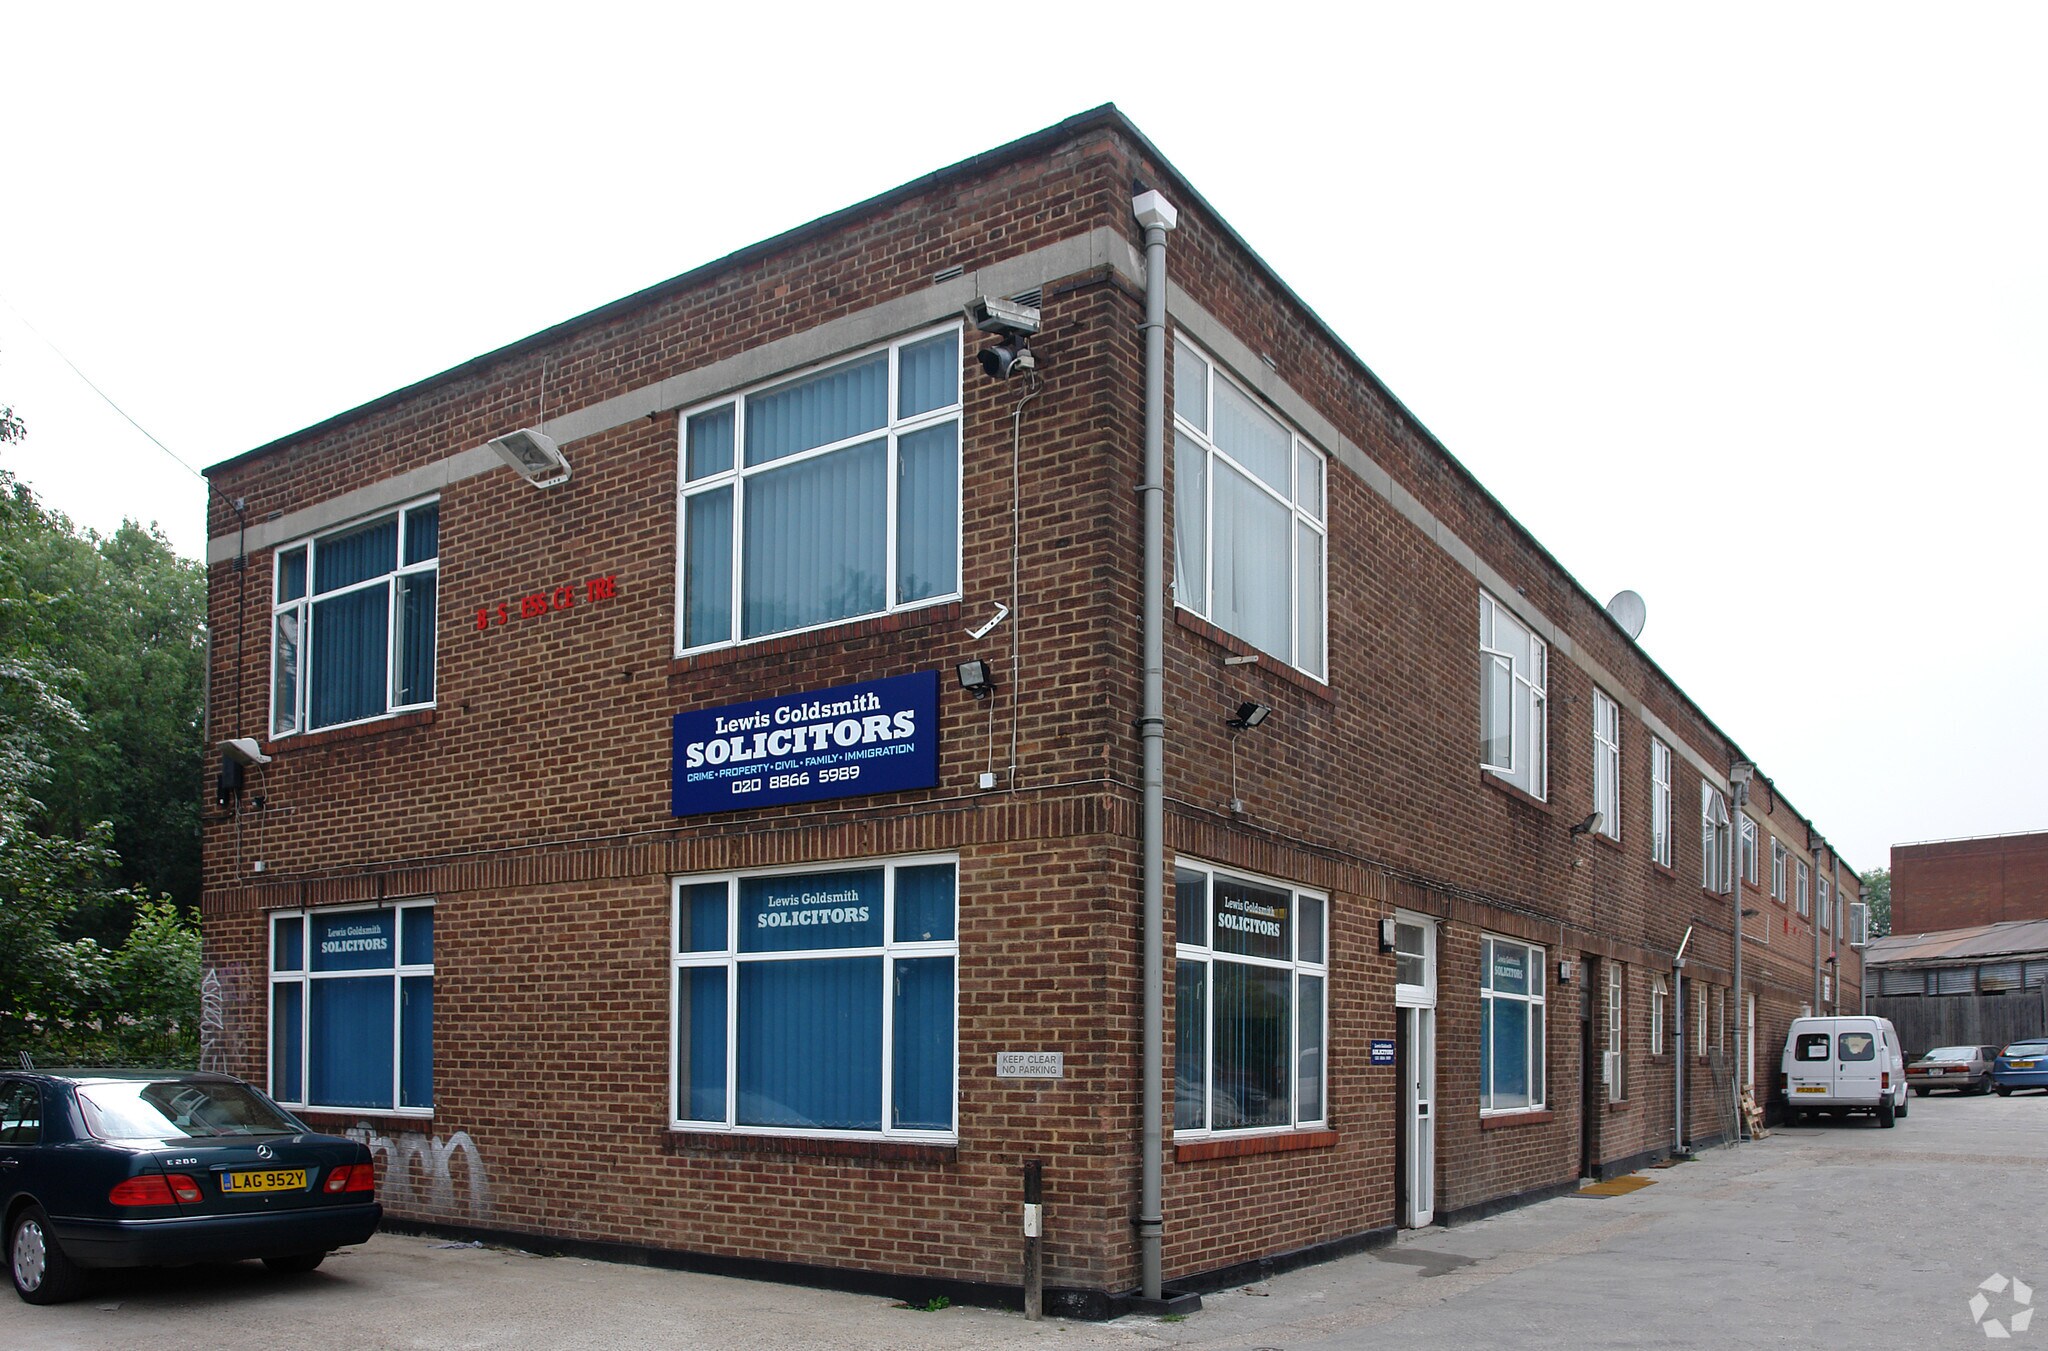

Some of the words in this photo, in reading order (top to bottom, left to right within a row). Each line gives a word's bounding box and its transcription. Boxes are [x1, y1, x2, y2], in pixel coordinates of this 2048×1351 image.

[715, 711, 771, 735] Lewis
[775, 692, 881, 725] Goldsmith
[686, 710, 916, 769] SOLICITORS
[731, 777, 762, 794] 020
[769, 772, 810, 789] 8866
[818, 765, 860, 783] 5989
[768, 894, 799, 907] Lewis
[801, 889, 859, 905] Goldsmith
[1224, 896, 1244, 911] Lewis
[1244, 901, 1275, 917] Goldsmith
[758, 906, 870, 928] SOLICITORS
[1218, 912, 1280, 937] SOLICITORS
[328, 927, 346, 937] Lewis
[347, 924, 382, 936] Goldsmith
[321, 938, 388, 953] SOLICITORS
[1002, 1055, 1025, 1064] KEEP
[1027, 1055, 1057, 1064] CLEAR
[1002, 1065, 1016, 1074] NO
[1018, 1065, 1057, 1074] PARKING
[232, 1174, 262, 1189] LAG
[266, 1172, 304, 1187] 952Y
